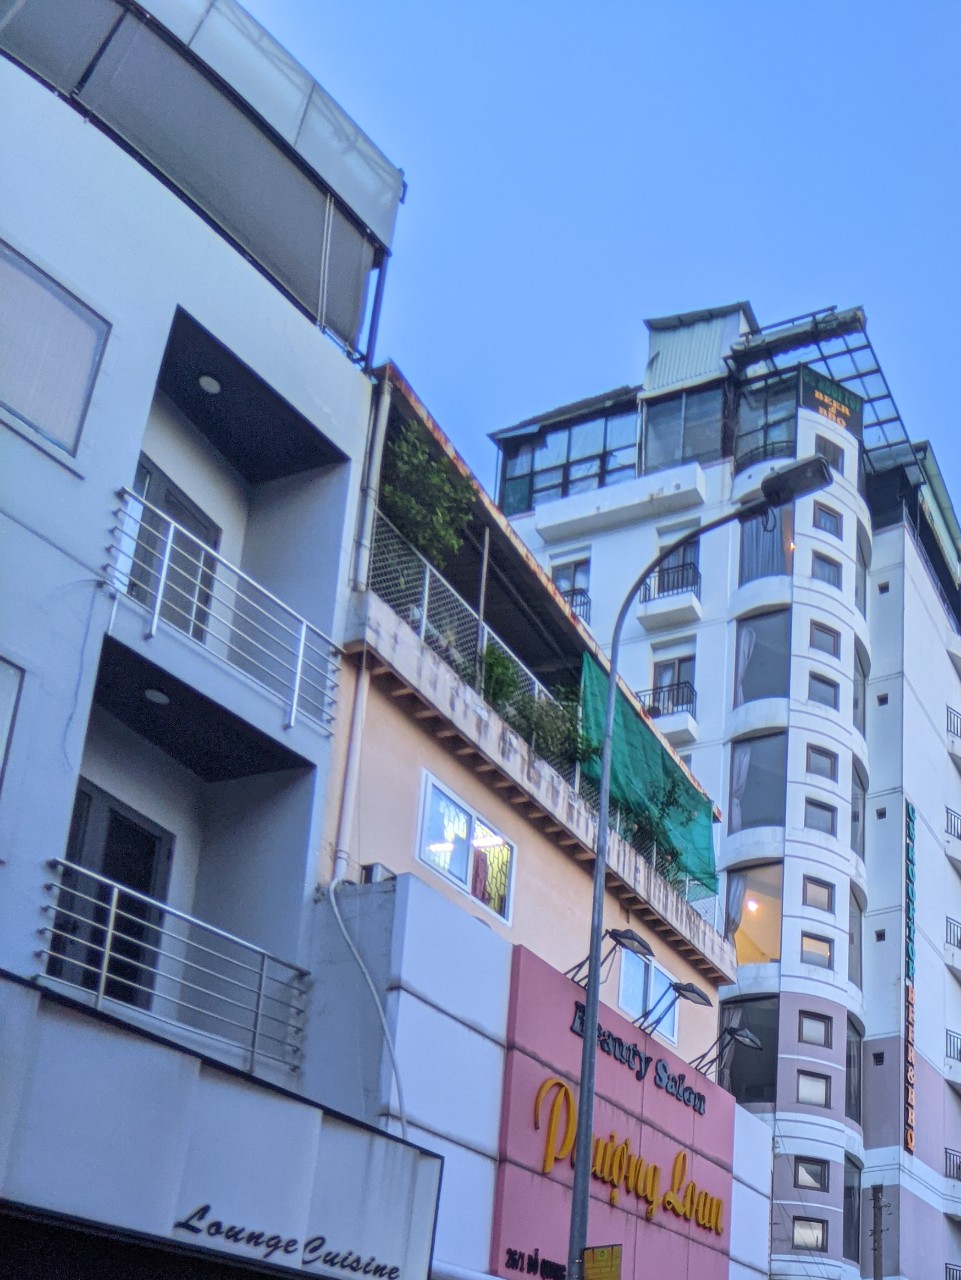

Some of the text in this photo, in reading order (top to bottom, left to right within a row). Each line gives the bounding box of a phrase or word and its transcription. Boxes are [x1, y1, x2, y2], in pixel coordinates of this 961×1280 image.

[570, 1001, 706, 1116] Bauty Salon
[534, 1077, 724, 1236] Pượng Loan
[174, 1204, 400, 1280] Lounge Cuisine
